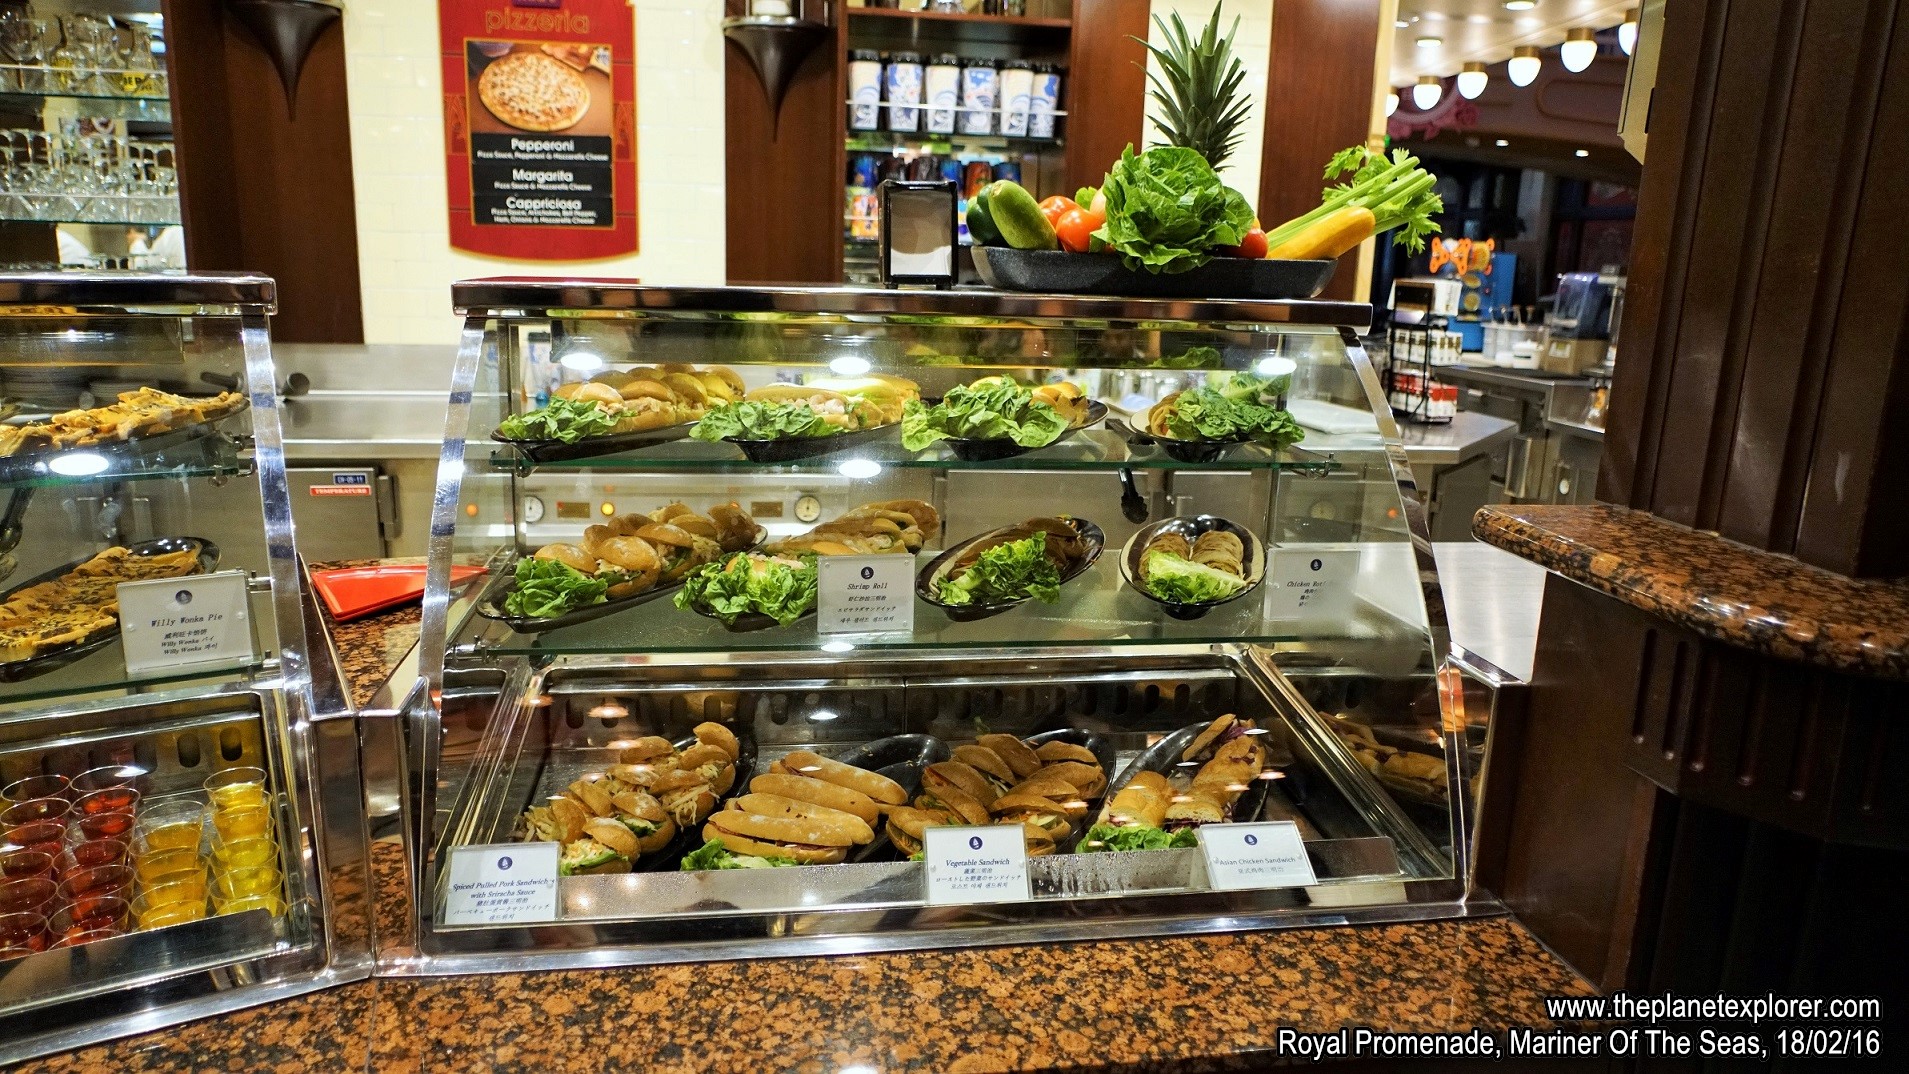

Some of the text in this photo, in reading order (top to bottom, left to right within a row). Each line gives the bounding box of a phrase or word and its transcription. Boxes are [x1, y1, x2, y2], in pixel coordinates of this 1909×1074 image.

[485, 9, 590, 34] pizzeria
[511, 137, 575, 152] Pepperoni
[512, 168, 574, 184] Margarita
[505, 196, 582, 210] Cappriciosa
[151, 613, 223, 627] Willy Wonka Pie
[946, 859, 977, 868] Vegetable
[453, 878, 549, 892] Spiced Pulled Pork Sandwich
[487, 890, 515, 898] Sriracha
